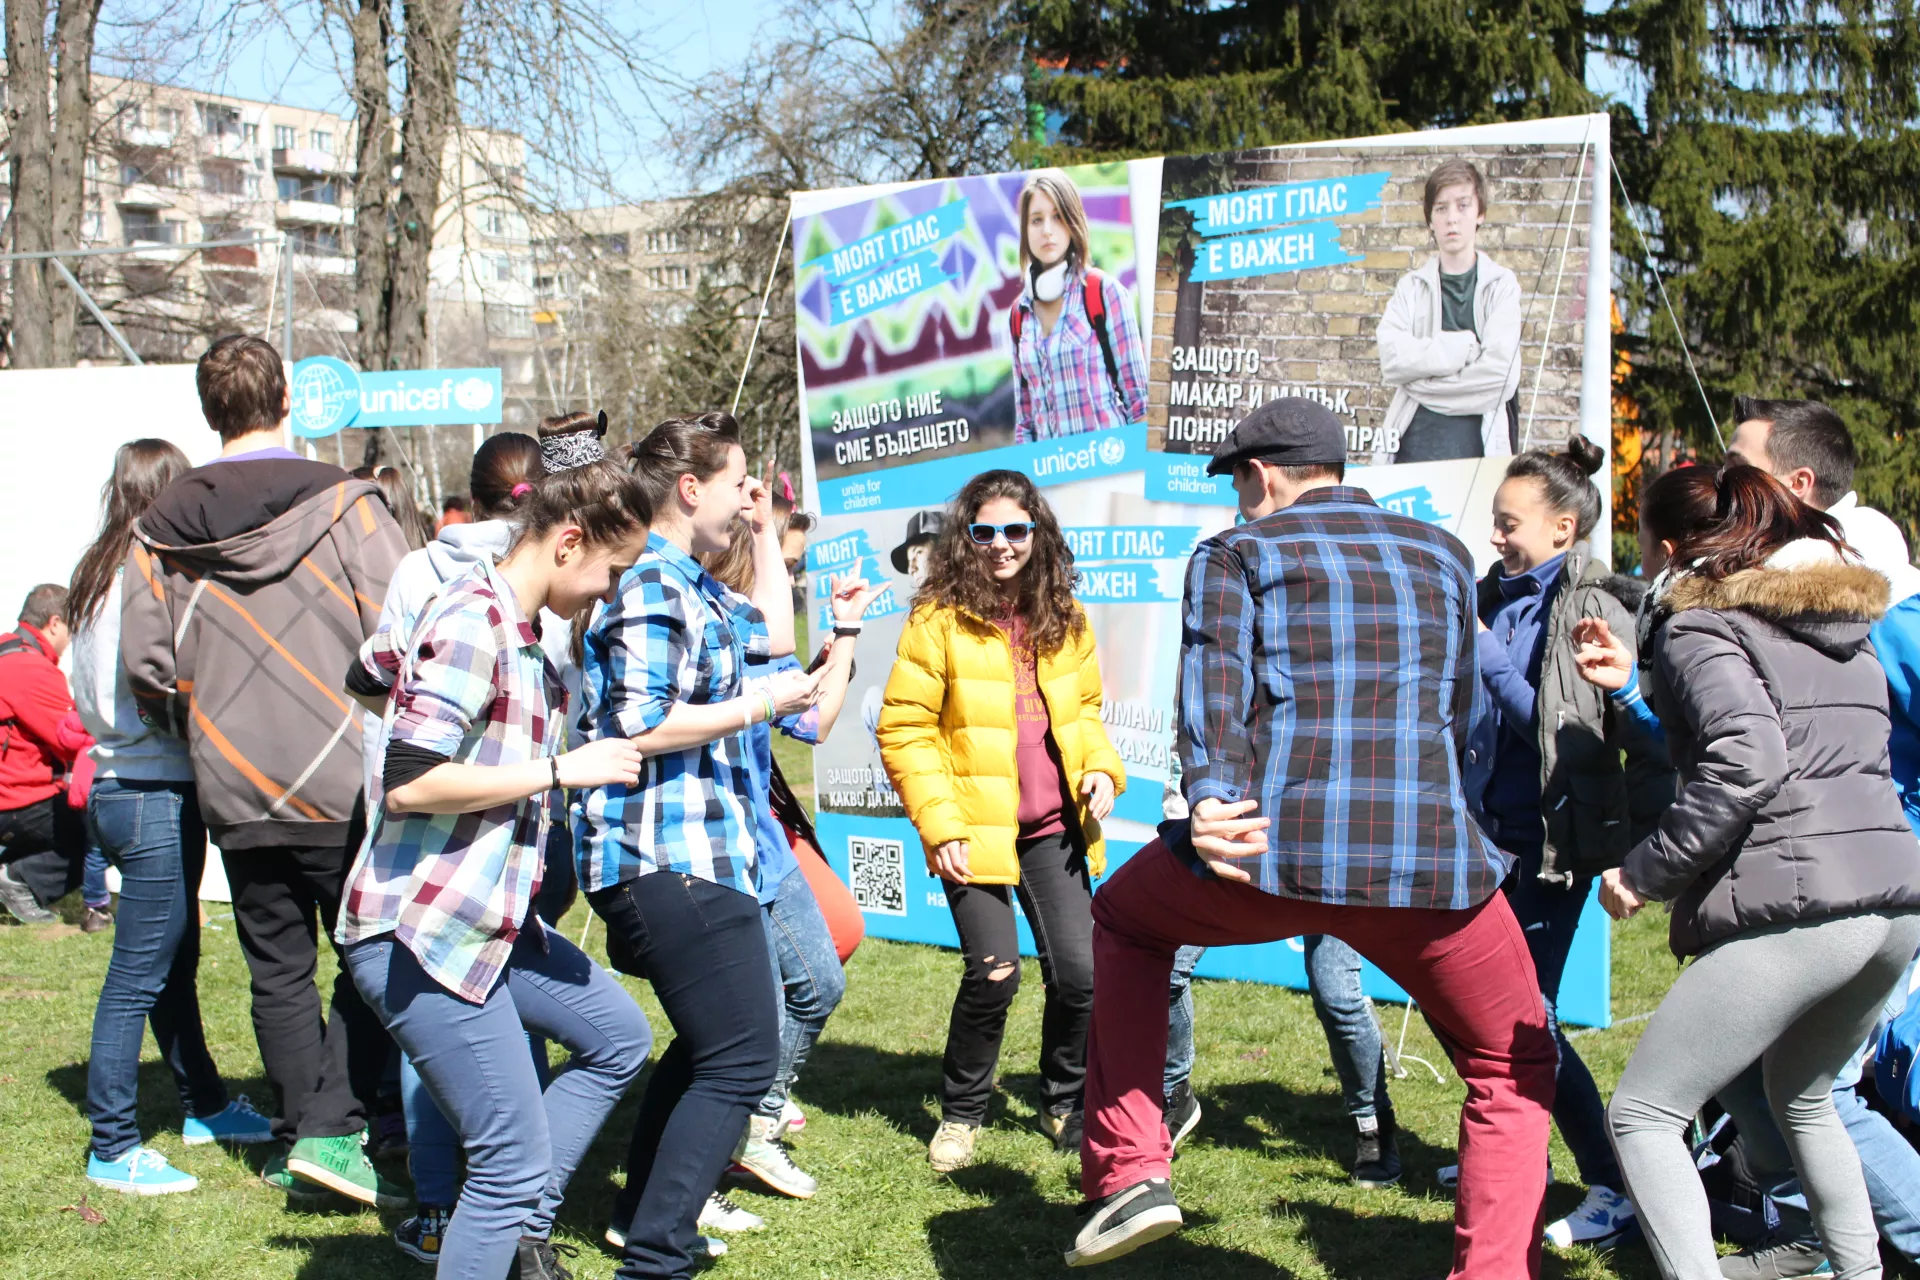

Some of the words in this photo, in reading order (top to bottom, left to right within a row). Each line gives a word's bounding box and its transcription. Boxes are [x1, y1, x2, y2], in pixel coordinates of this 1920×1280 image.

[1208, 191, 1278, 227] МОЯТ
[1285, 183, 1348, 218] ГЛАС
[832, 235, 885, 277] МОЯТ
[890, 215, 940, 255] ГЛАС
[1209, 243, 1223, 273] Е
[1230, 232, 1314, 269] ВАЖЕН
[841, 289, 855, 316] Е
[855, 263, 922, 308] ВАЖЕН
[1172, 346, 1260, 374] ЗАЩОТО
[360, 378, 454, 414] unicef
[1170, 381, 1243, 409] МАКАР
[1248, 383, 1264, 410] И
[831, 398, 902, 434] ЗАЩОТО
[905, 389, 943, 419] НИЕ
[834, 437, 873, 466] СМЕ
[874, 418, 970, 457] БЪДЕЩЕТО
[1033, 439, 1097, 477] unicef
[1167, 462, 1199, 477] unite
[841, 482, 866, 497] unite
[866, 479, 882, 492] for
[1167, 478, 1217, 495] children
[843, 495, 881, 511] children
[815, 536, 859, 567] МОЯТ
[1064, 529, 1106, 556] ОЯТ
[1111, 529, 1165, 557] ГЛАС
[1072, 571, 1137, 599] АЖЕН
[827, 767, 872, 787] ЗАЩОТО
[828, 790, 865, 808] КАКВО
[866, 789, 883, 809] ДА
